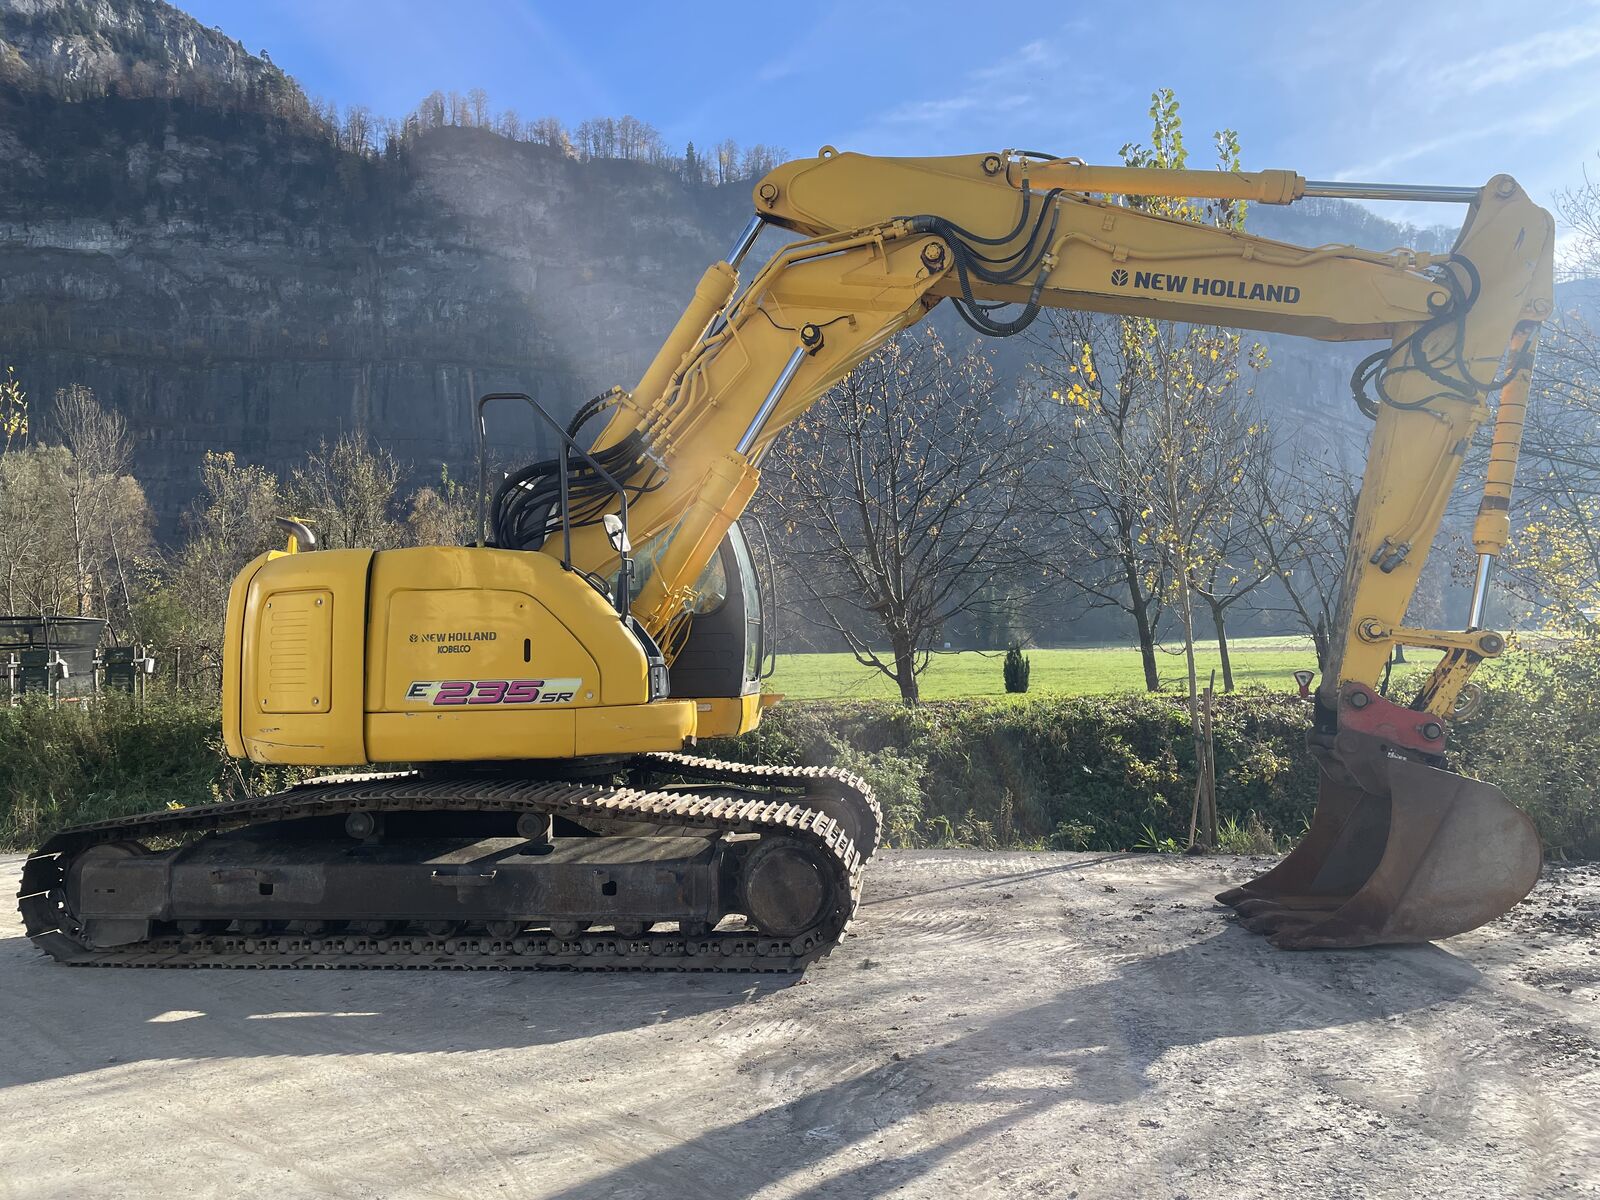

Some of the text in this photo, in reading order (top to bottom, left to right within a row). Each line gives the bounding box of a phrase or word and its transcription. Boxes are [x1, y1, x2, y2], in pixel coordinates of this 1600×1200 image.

[1134, 271, 1300, 304] NEW HOLLAND
[421, 631, 497, 642] NEW HOLLAND
[437, 645, 471, 654] KOBELCO
